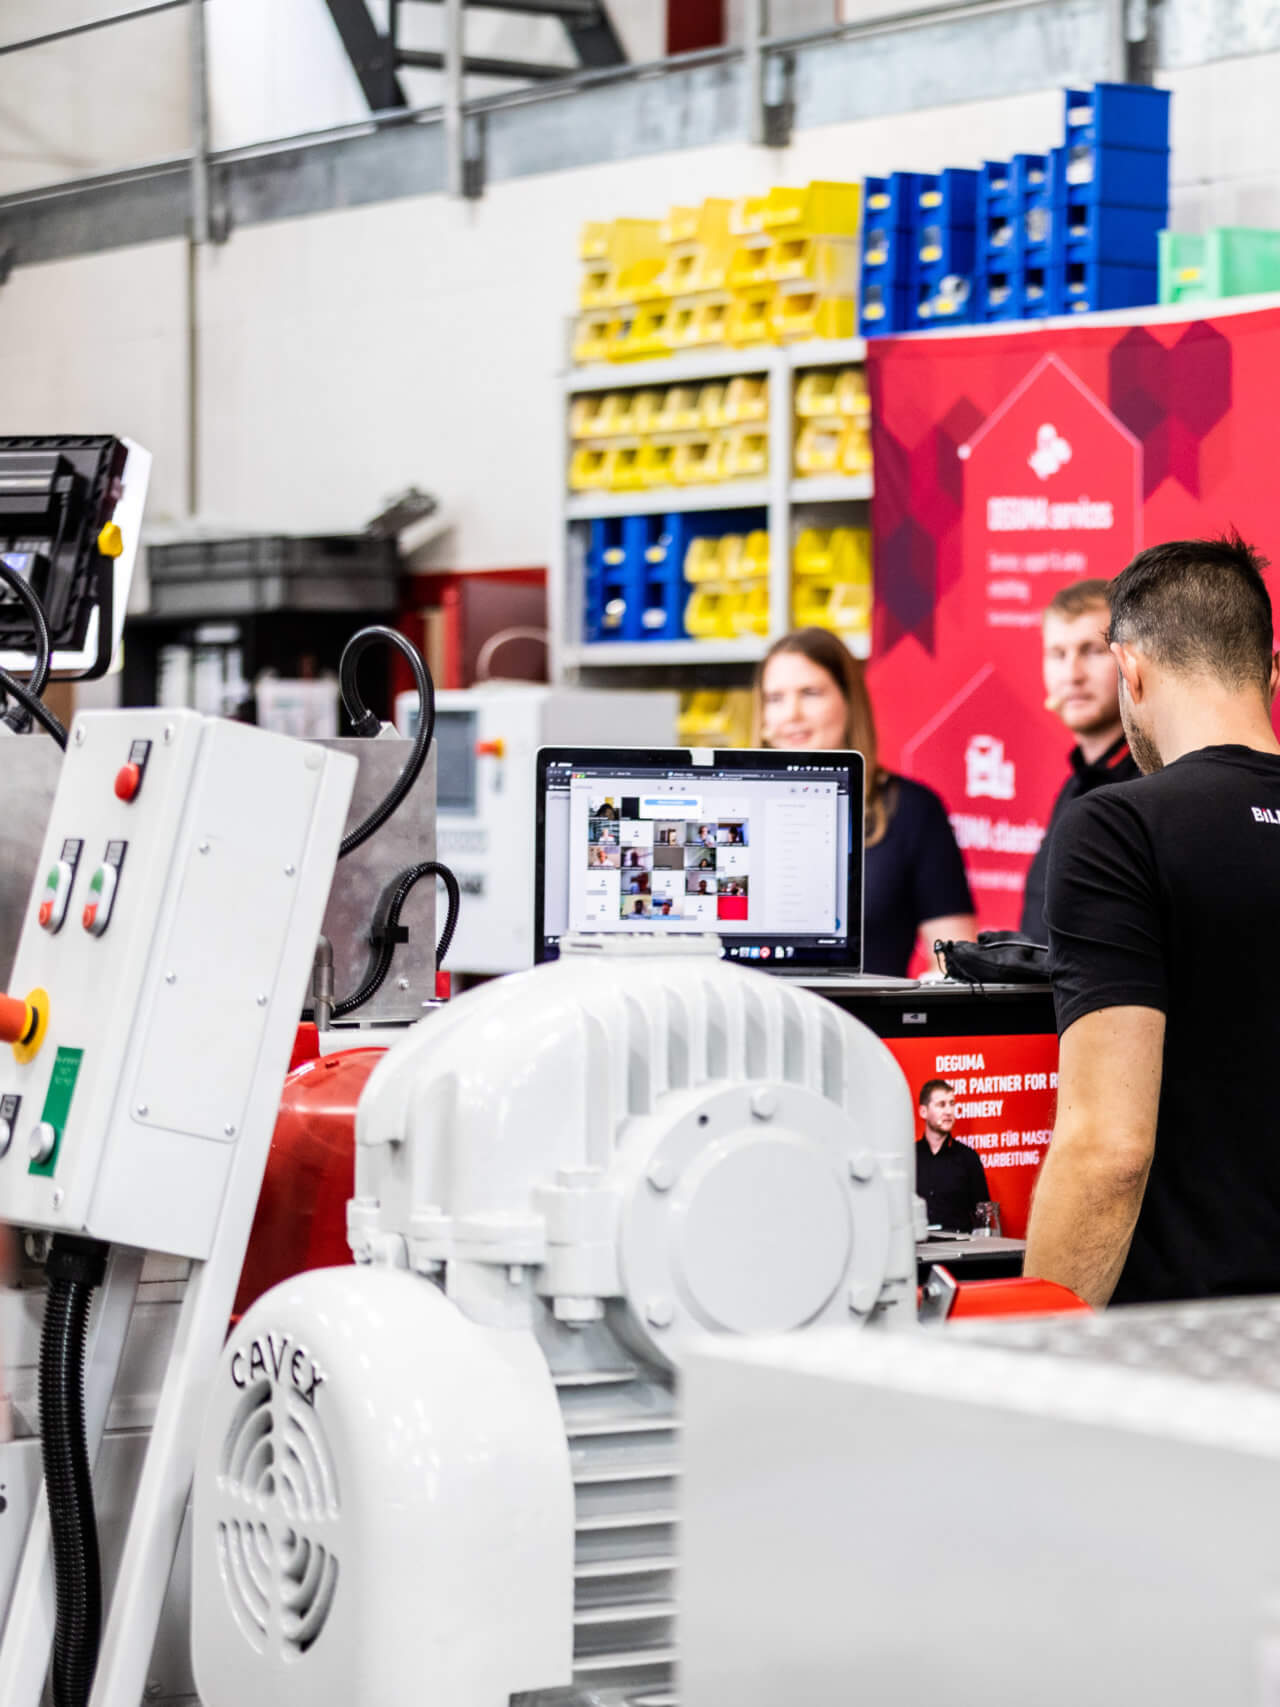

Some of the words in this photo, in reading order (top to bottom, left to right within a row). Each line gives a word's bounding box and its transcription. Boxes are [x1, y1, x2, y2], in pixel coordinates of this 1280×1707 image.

[935, 1053, 985, 1073] DEGUMA
[969, 1074, 1022, 1095] PARTNER
[1024, 1071, 1049, 1091] FOR
[954, 1099, 1004, 1119] CHINERY
[1000, 1128, 1020, 1147] FÜR
[980, 1150, 1040, 1169] RARBEITUNG
[231, 1334, 324, 1404] CAVEX
